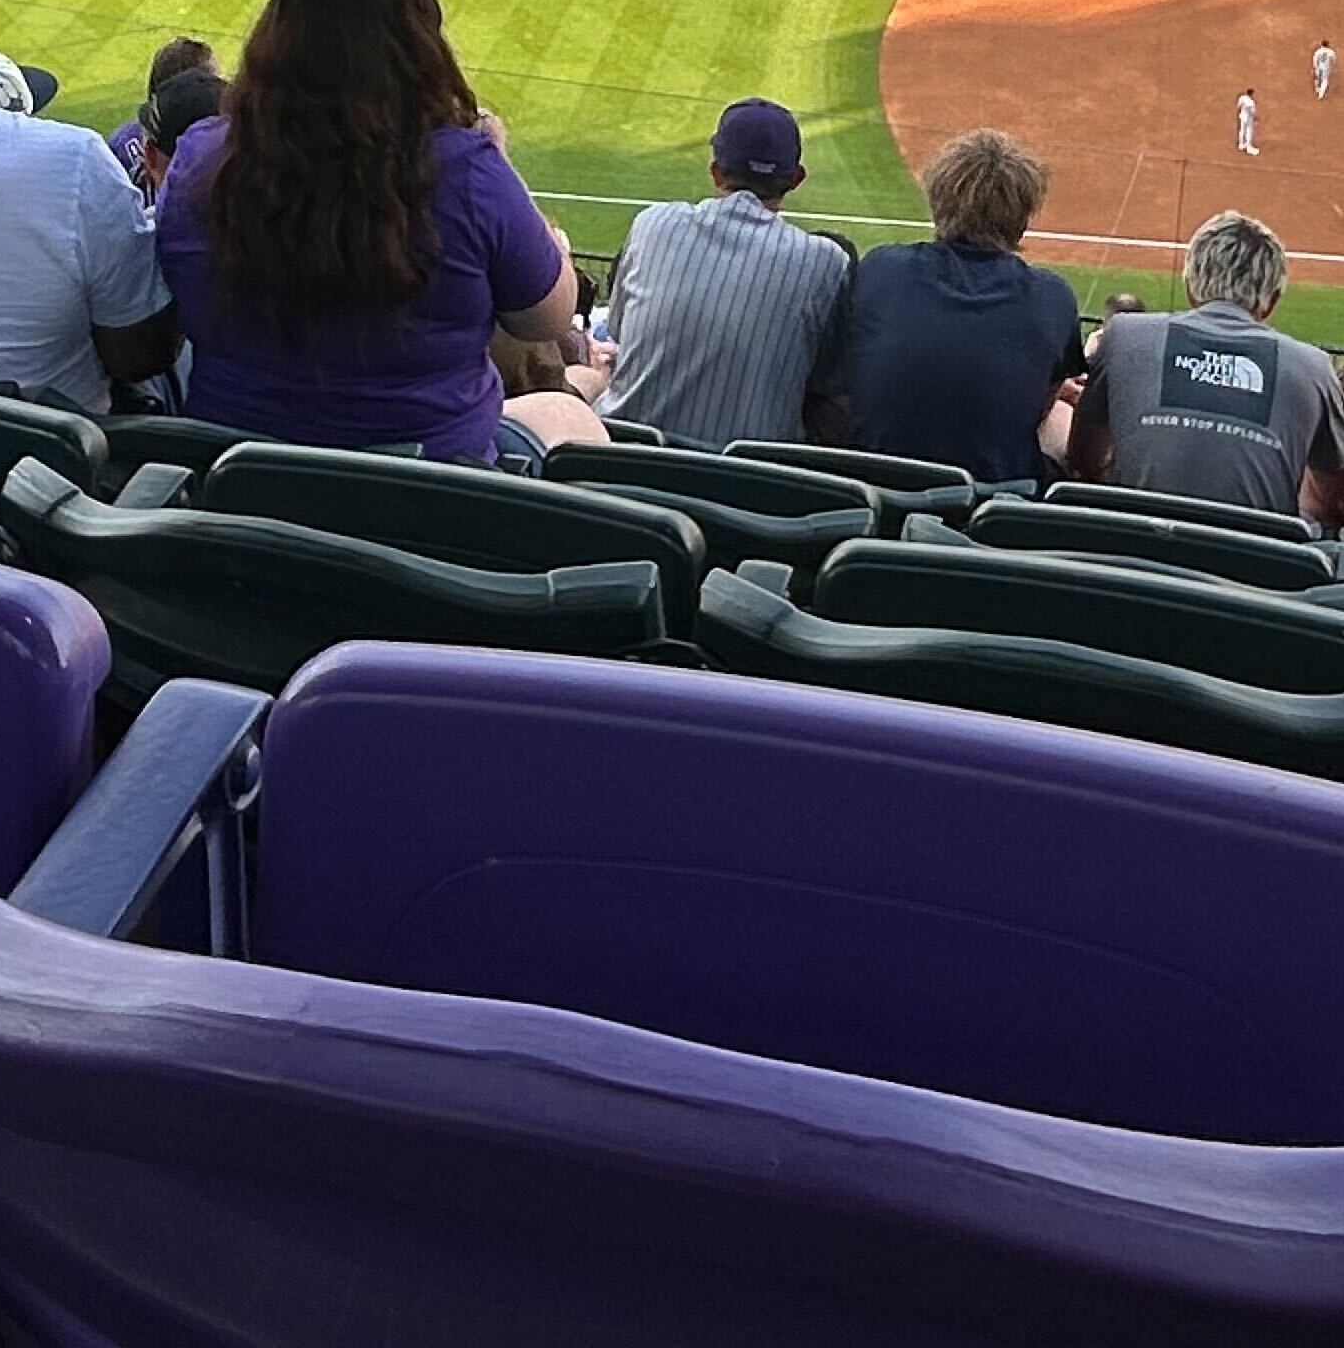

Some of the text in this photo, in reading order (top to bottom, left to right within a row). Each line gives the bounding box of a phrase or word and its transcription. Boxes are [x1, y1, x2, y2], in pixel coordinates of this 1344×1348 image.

[1174, 354, 1235, 376] NORTH
[1203, 350, 1235, 367] THE
[1190, 369, 1236, 387] FACE
[1140, 413, 1179, 428] NEVER
[1181, 416, 1215, 431] STOP
